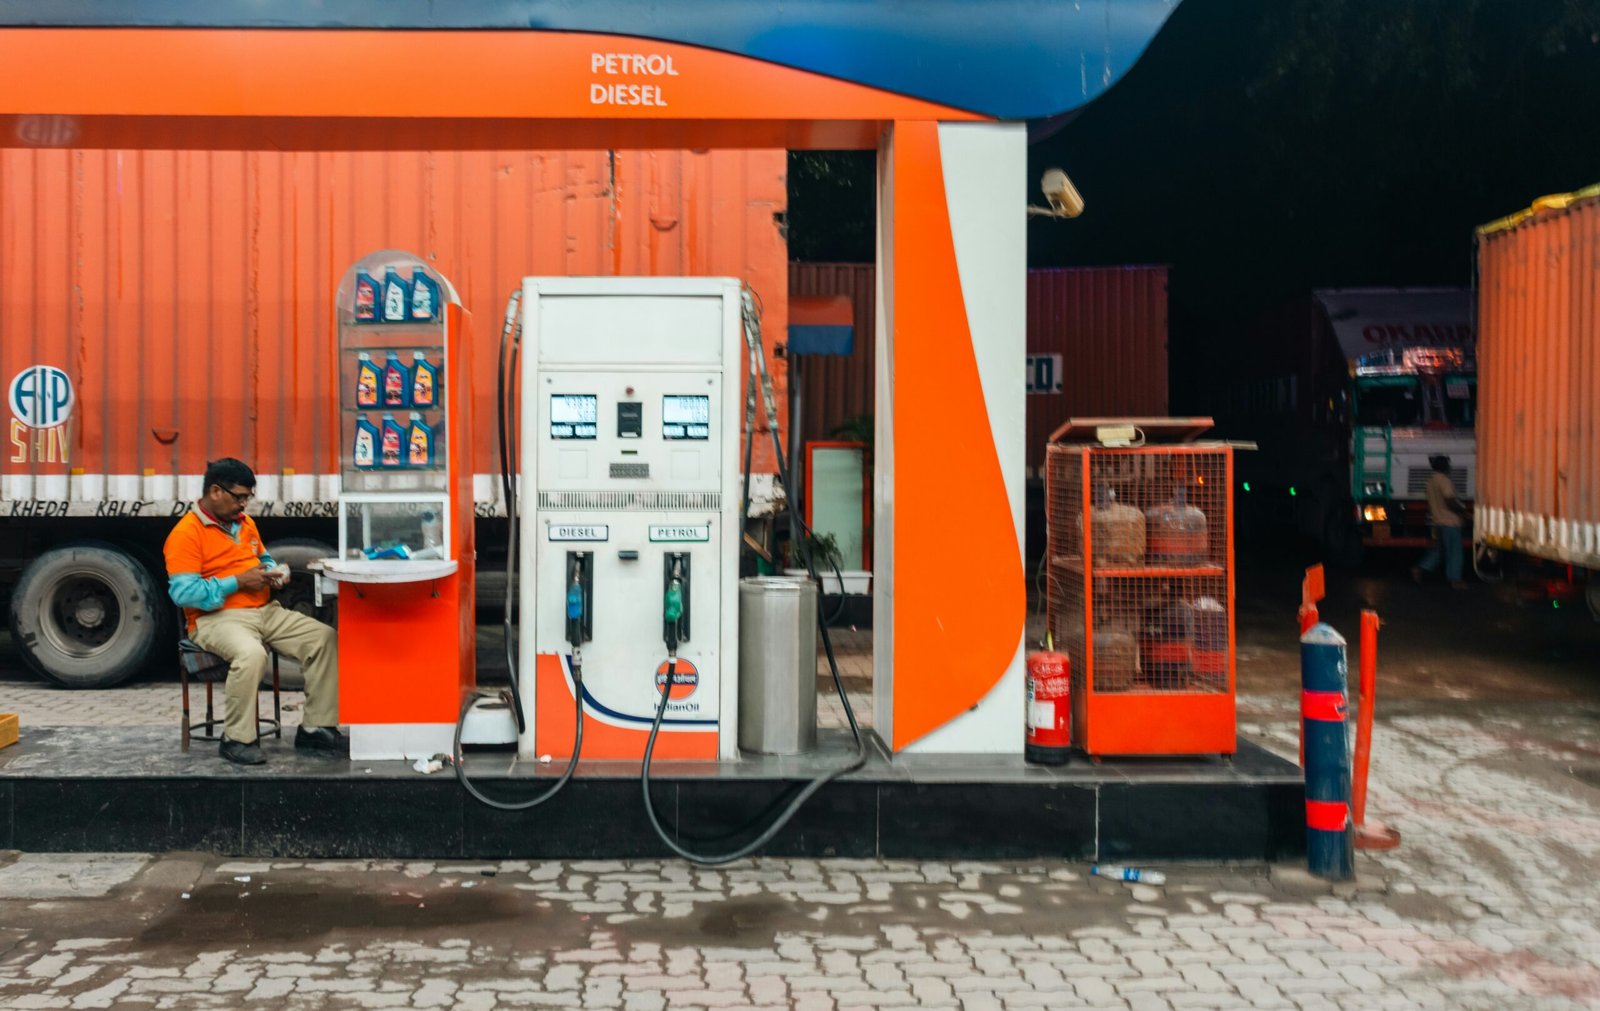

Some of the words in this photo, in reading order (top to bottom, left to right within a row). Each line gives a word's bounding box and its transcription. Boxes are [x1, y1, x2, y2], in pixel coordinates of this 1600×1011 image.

[591, 53, 680, 76] PETROL
[590, 83, 668, 106] DIESEL
[10, 416, 75, 463] SHIV
[10, 500, 70, 517] KHEDA
[95, 500, 143, 517] KALA
[559, 528, 598, 537] DIESEL
[658, 528, 700, 537] PETROL
[654, 703, 700, 712] IdianOil
